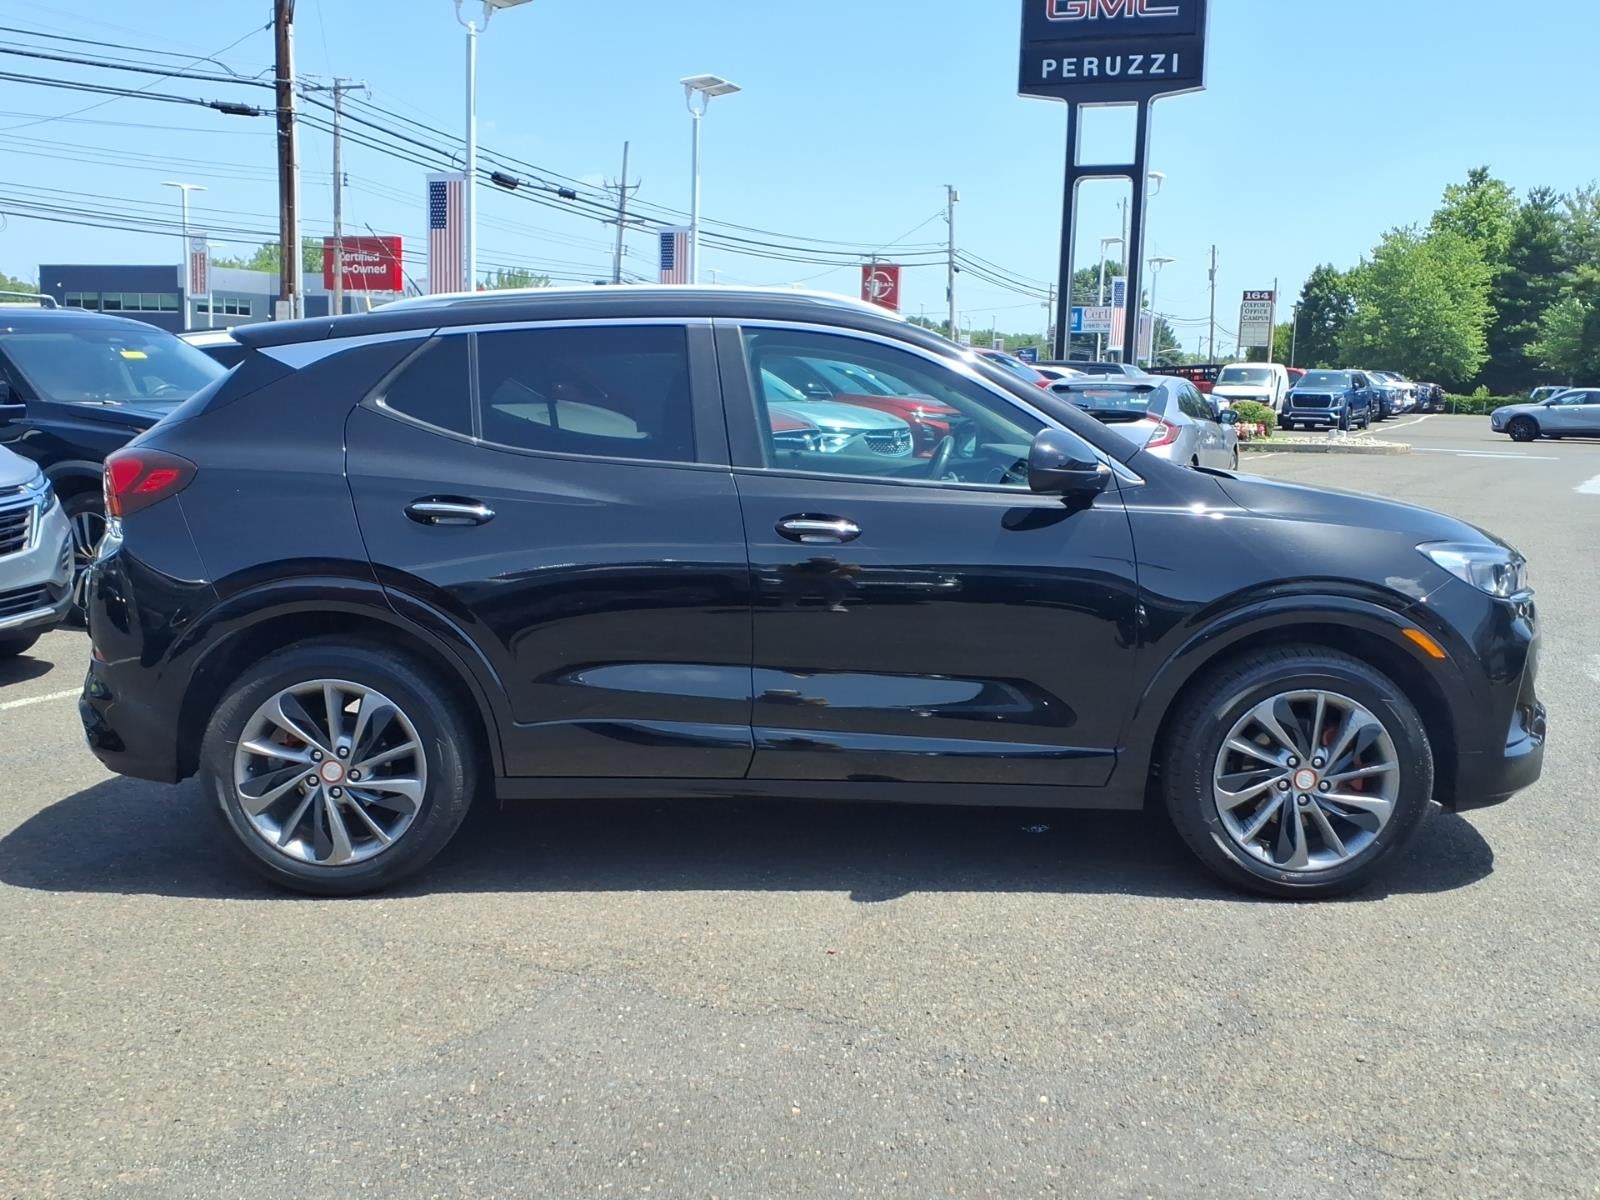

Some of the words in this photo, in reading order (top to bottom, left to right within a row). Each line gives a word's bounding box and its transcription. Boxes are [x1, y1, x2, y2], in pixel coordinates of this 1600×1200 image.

[1045, 0, 1180, 21] GMC
[1041, 53, 1180, 79] PERUZZI
[340, 251, 380, 262] Certified
[331, 263, 387, 274] e-Owned
[1245, 292, 1270, 300] 164
